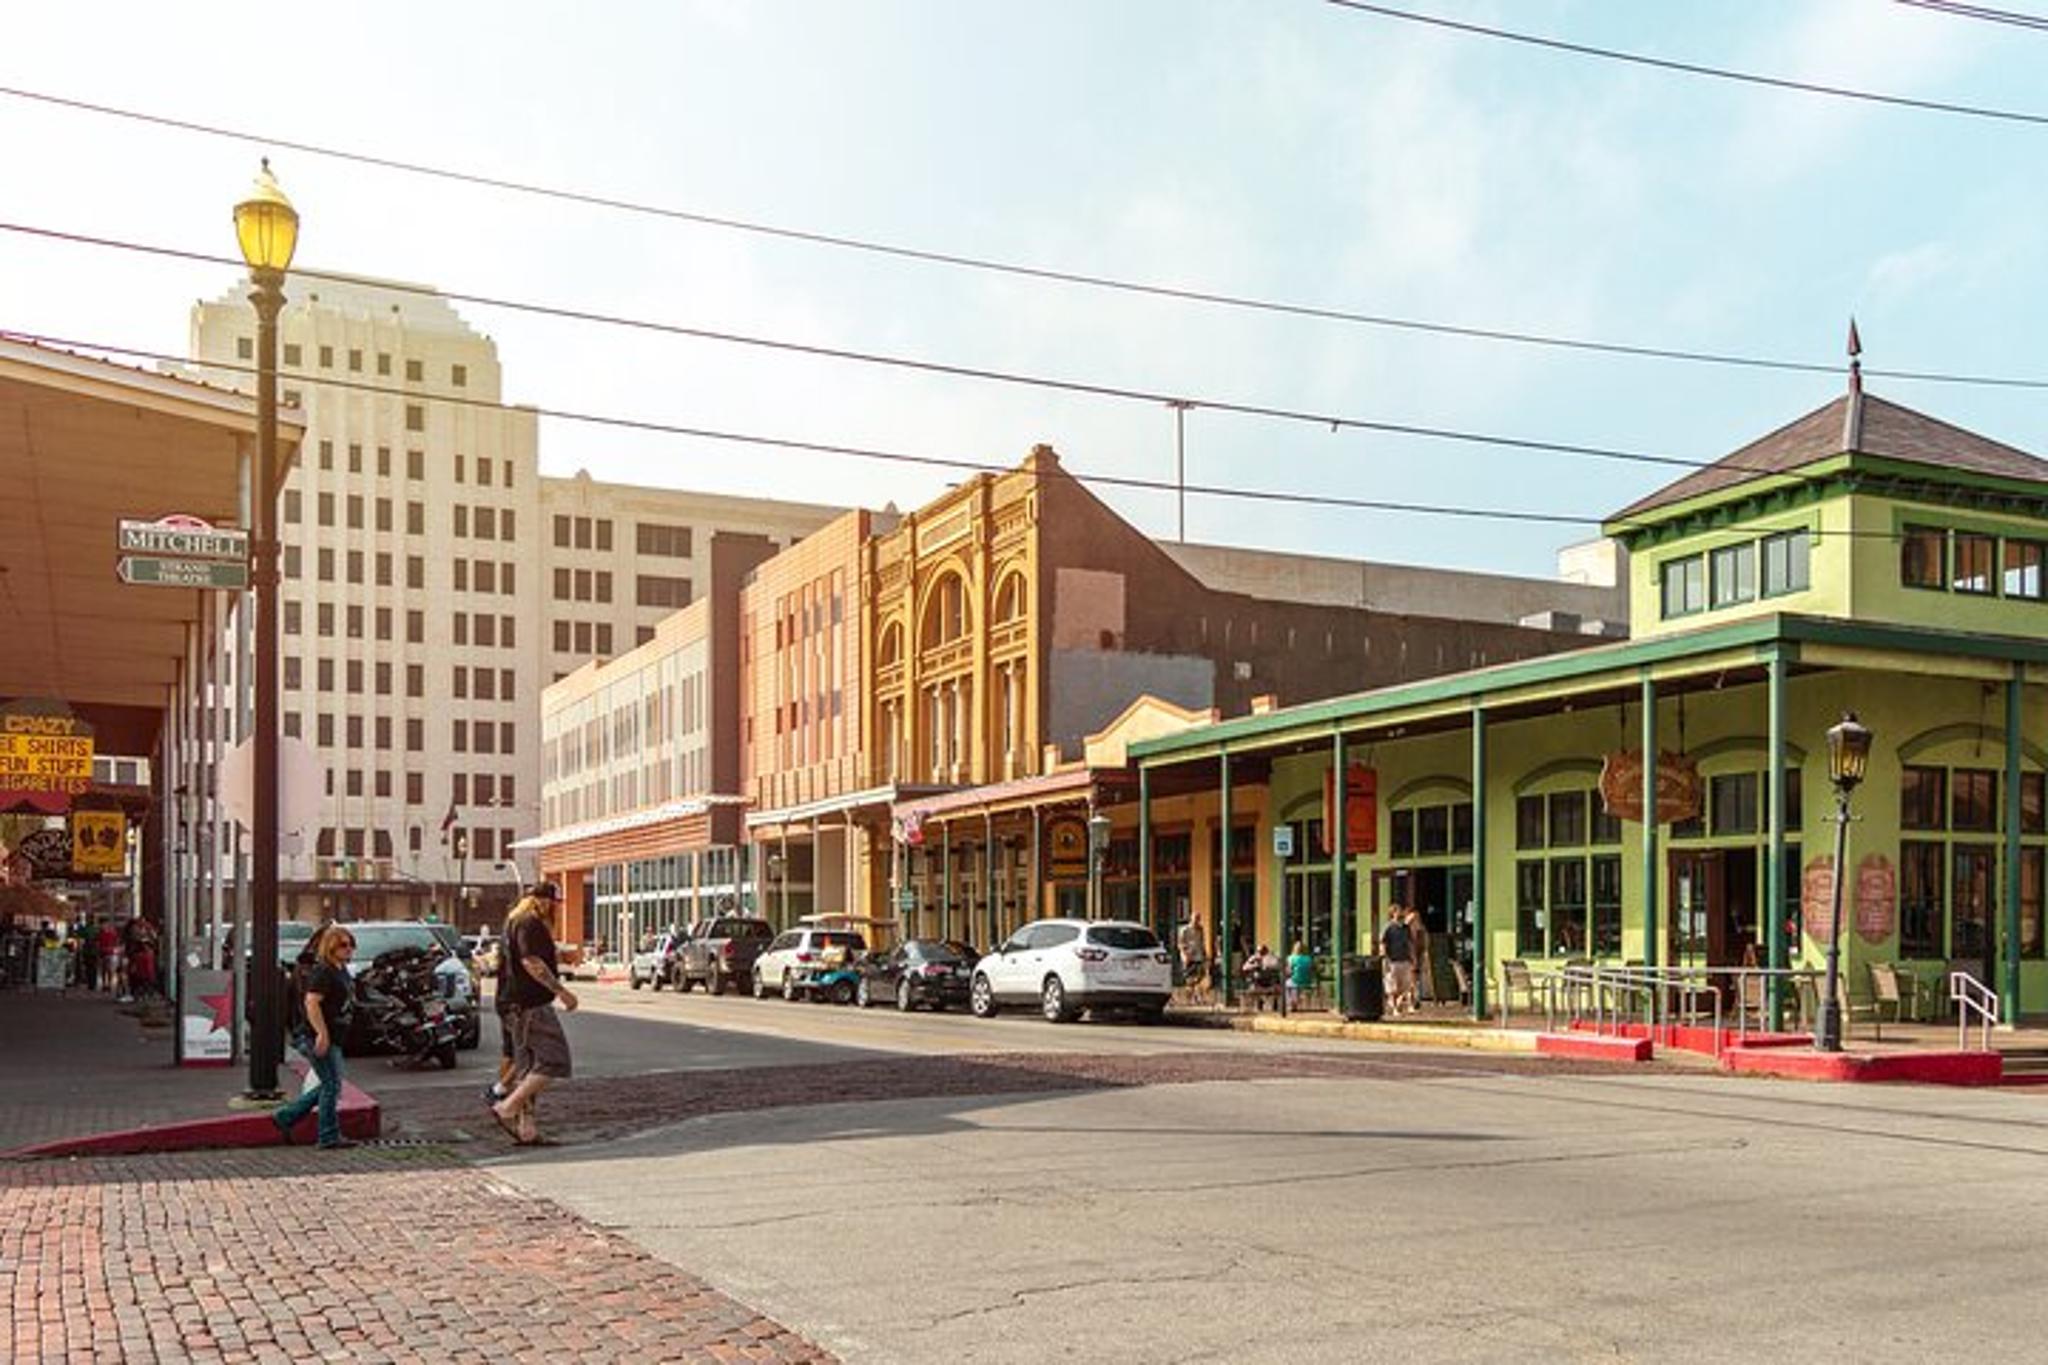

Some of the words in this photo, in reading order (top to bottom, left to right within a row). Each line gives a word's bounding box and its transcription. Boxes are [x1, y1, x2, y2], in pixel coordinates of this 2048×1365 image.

[126, 530, 244, 556] MITCHELL
[6, 715, 75, 735] CRAZY
[28, 738, 88, 757] SHIRTS
[0, 755, 29, 773] FUN
[37, 758, 86, 775] STUFF
